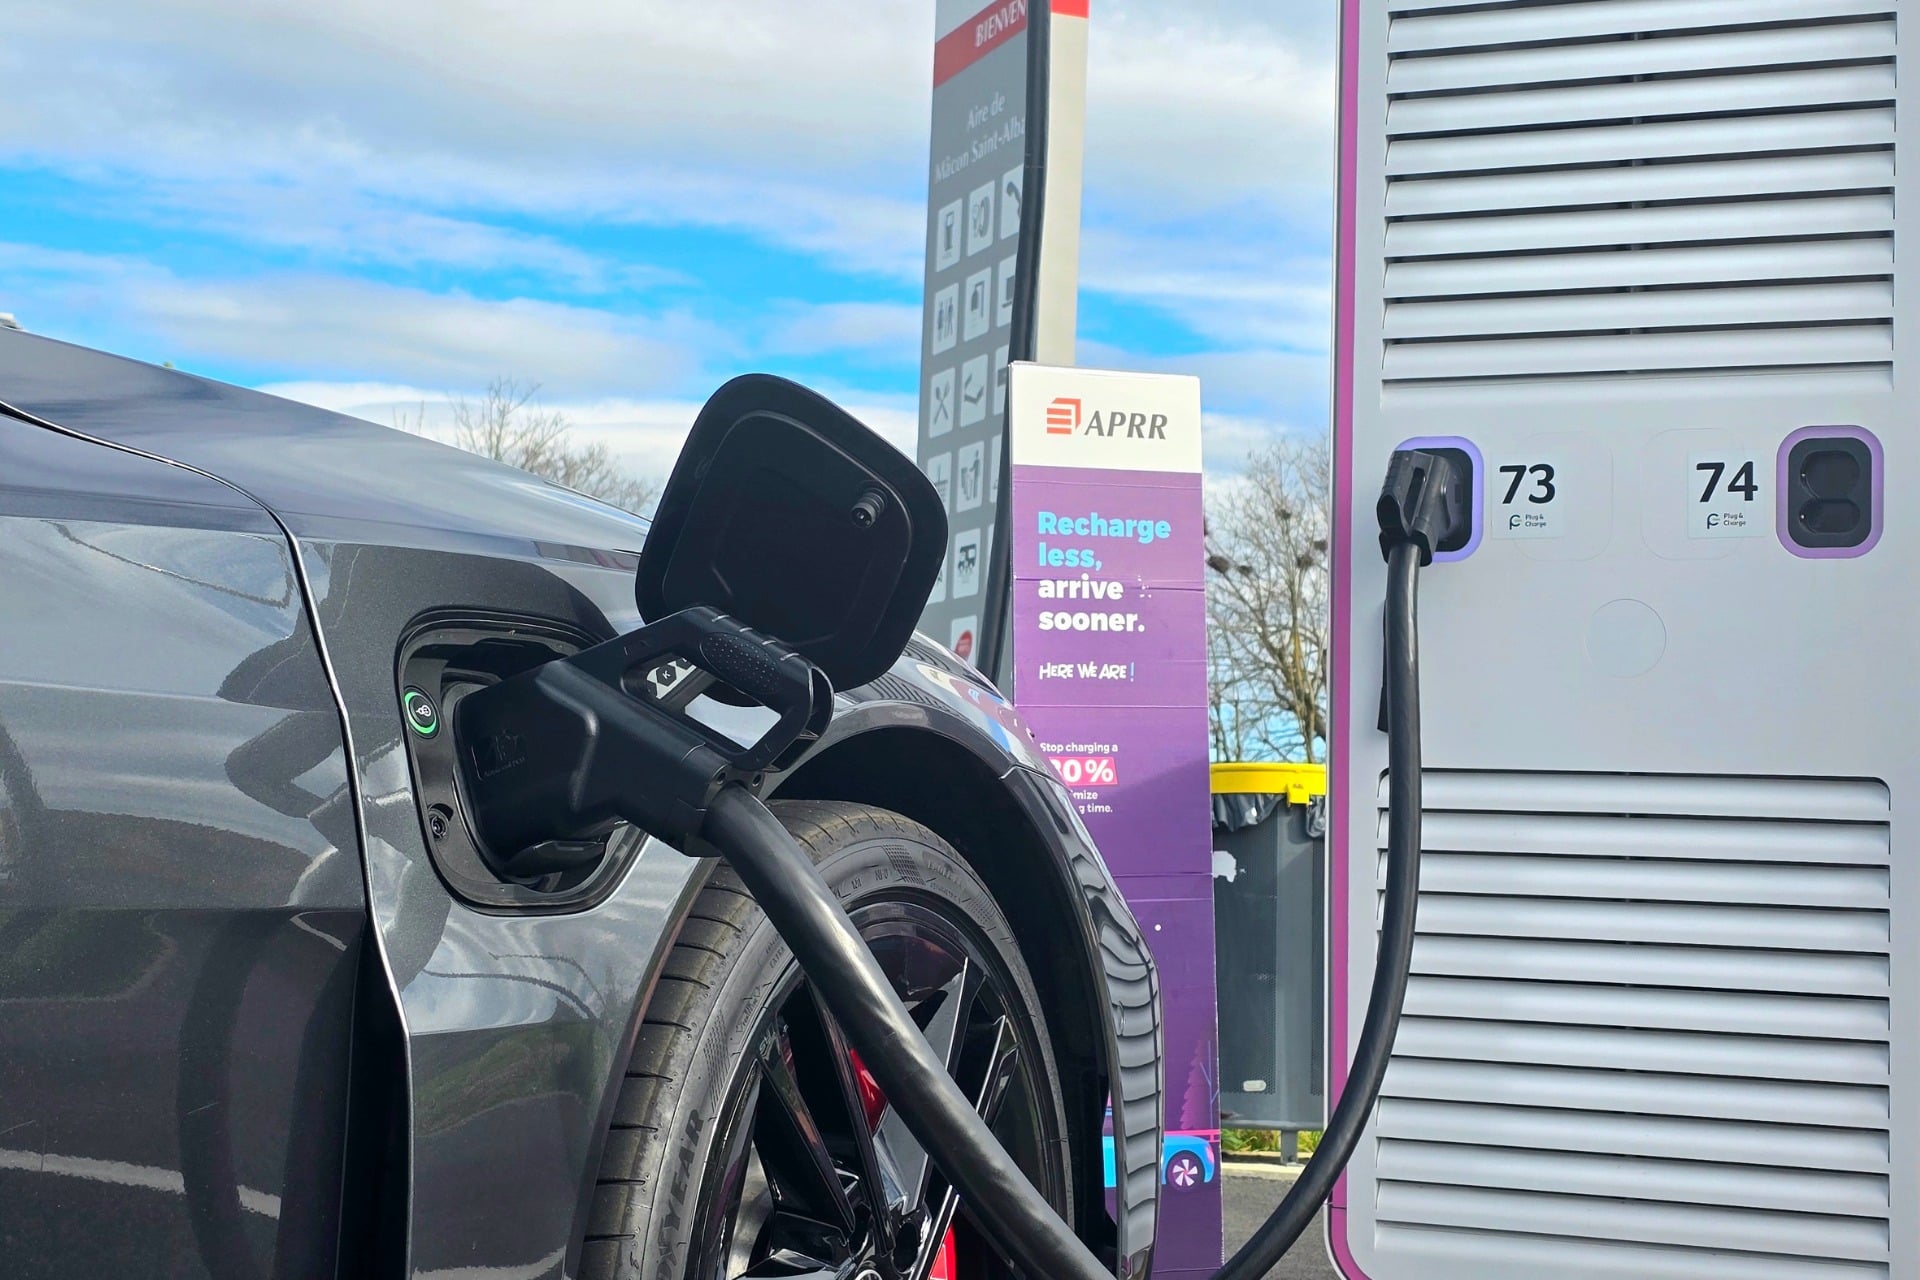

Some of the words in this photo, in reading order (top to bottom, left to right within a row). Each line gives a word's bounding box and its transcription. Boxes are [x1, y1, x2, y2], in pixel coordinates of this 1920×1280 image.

[966, 105, 989, 132] Aire
[991, 91, 1006, 115] de
[1084, 410, 1168, 440] APRR
[1499, 464, 1556, 504] 73
[1696, 461, 1758, 502] 74
[1038, 511, 1171, 544] Recharge
[1039, 542, 1102, 571] less,
[1039, 573, 1124, 599] arrive
[1038, 611, 1145, 632] sooner.
[1039, 662, 1074, 680] HERE
[1077, 661, 1098, 679] WE
[1040, 743, 1064, 754] Stop
[1065, 742, 1110, 754] charging
[1071, 789, 1098, 800] mize
[1087, 803, 1113, 813] time.
